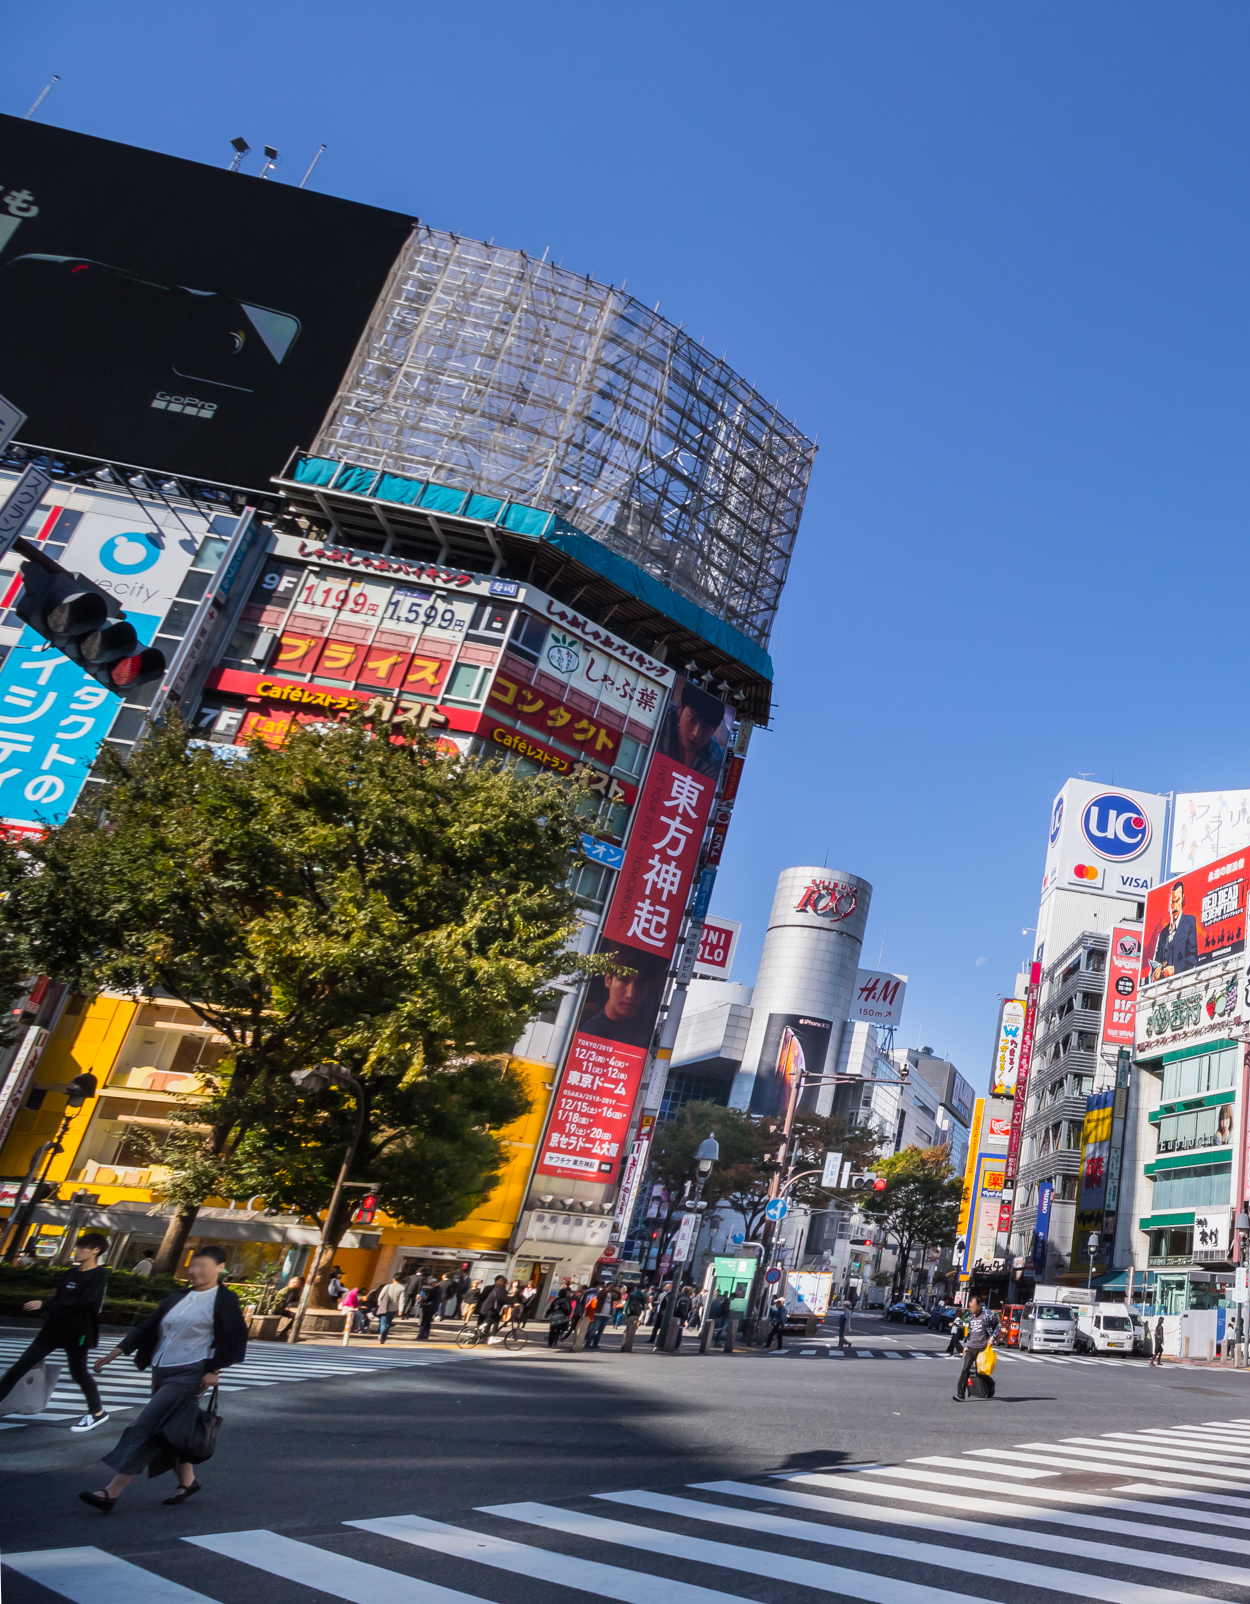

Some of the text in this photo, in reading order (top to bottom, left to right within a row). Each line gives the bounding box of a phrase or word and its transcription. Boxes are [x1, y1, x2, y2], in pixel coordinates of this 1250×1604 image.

[155, 391, 218, 411] GoPro
[298, 540, 475, 587] しゃぶしゃぶバイキング
[262, 573, 298, 592] 9F
[303, 583, 380, 616] 1,199円
[389, 599, 467, 631] 1,599円
[547, 600, 670, 679] しゃぶしゃぶバイキング
[279, 636, 444, 686] プライス
[585, 656, 659, 713] しゃぶ葉
[200, 707, 242, 731] 7F
[256, 682, 448, 728] Caféレストラン ガスト
[490, 675, 615, 751] コンタクト
[492, 727, 569, 772] Caféレストラン
[649, 792, 662, 816] TOUR
[1089, 805, 1143, 844] UC
[626, 771, 705, 948] 東方神起
[710, 833, 723, 858] ガスト
[811, 878, 859, 895] SHIBUYA
[1120, 874, 1149, 890] VISA
[792, 885, 859, 923] 109
[857, 977, 901, 1006] H&M
[804, 1018, 822, 1028] iPhone
[858, 1008, 883, 1019] 150m
[577, 1038, 614, 1053] TOKYO/2018
[566, 1070, 627, 1096] 東京ドーム
[548, 1132, 620, 1158] 京セラドーム大阪
[968, 1138, 978, 1175] Matsumoto
[1159, 1134, 1213, 1152] Euphoria
